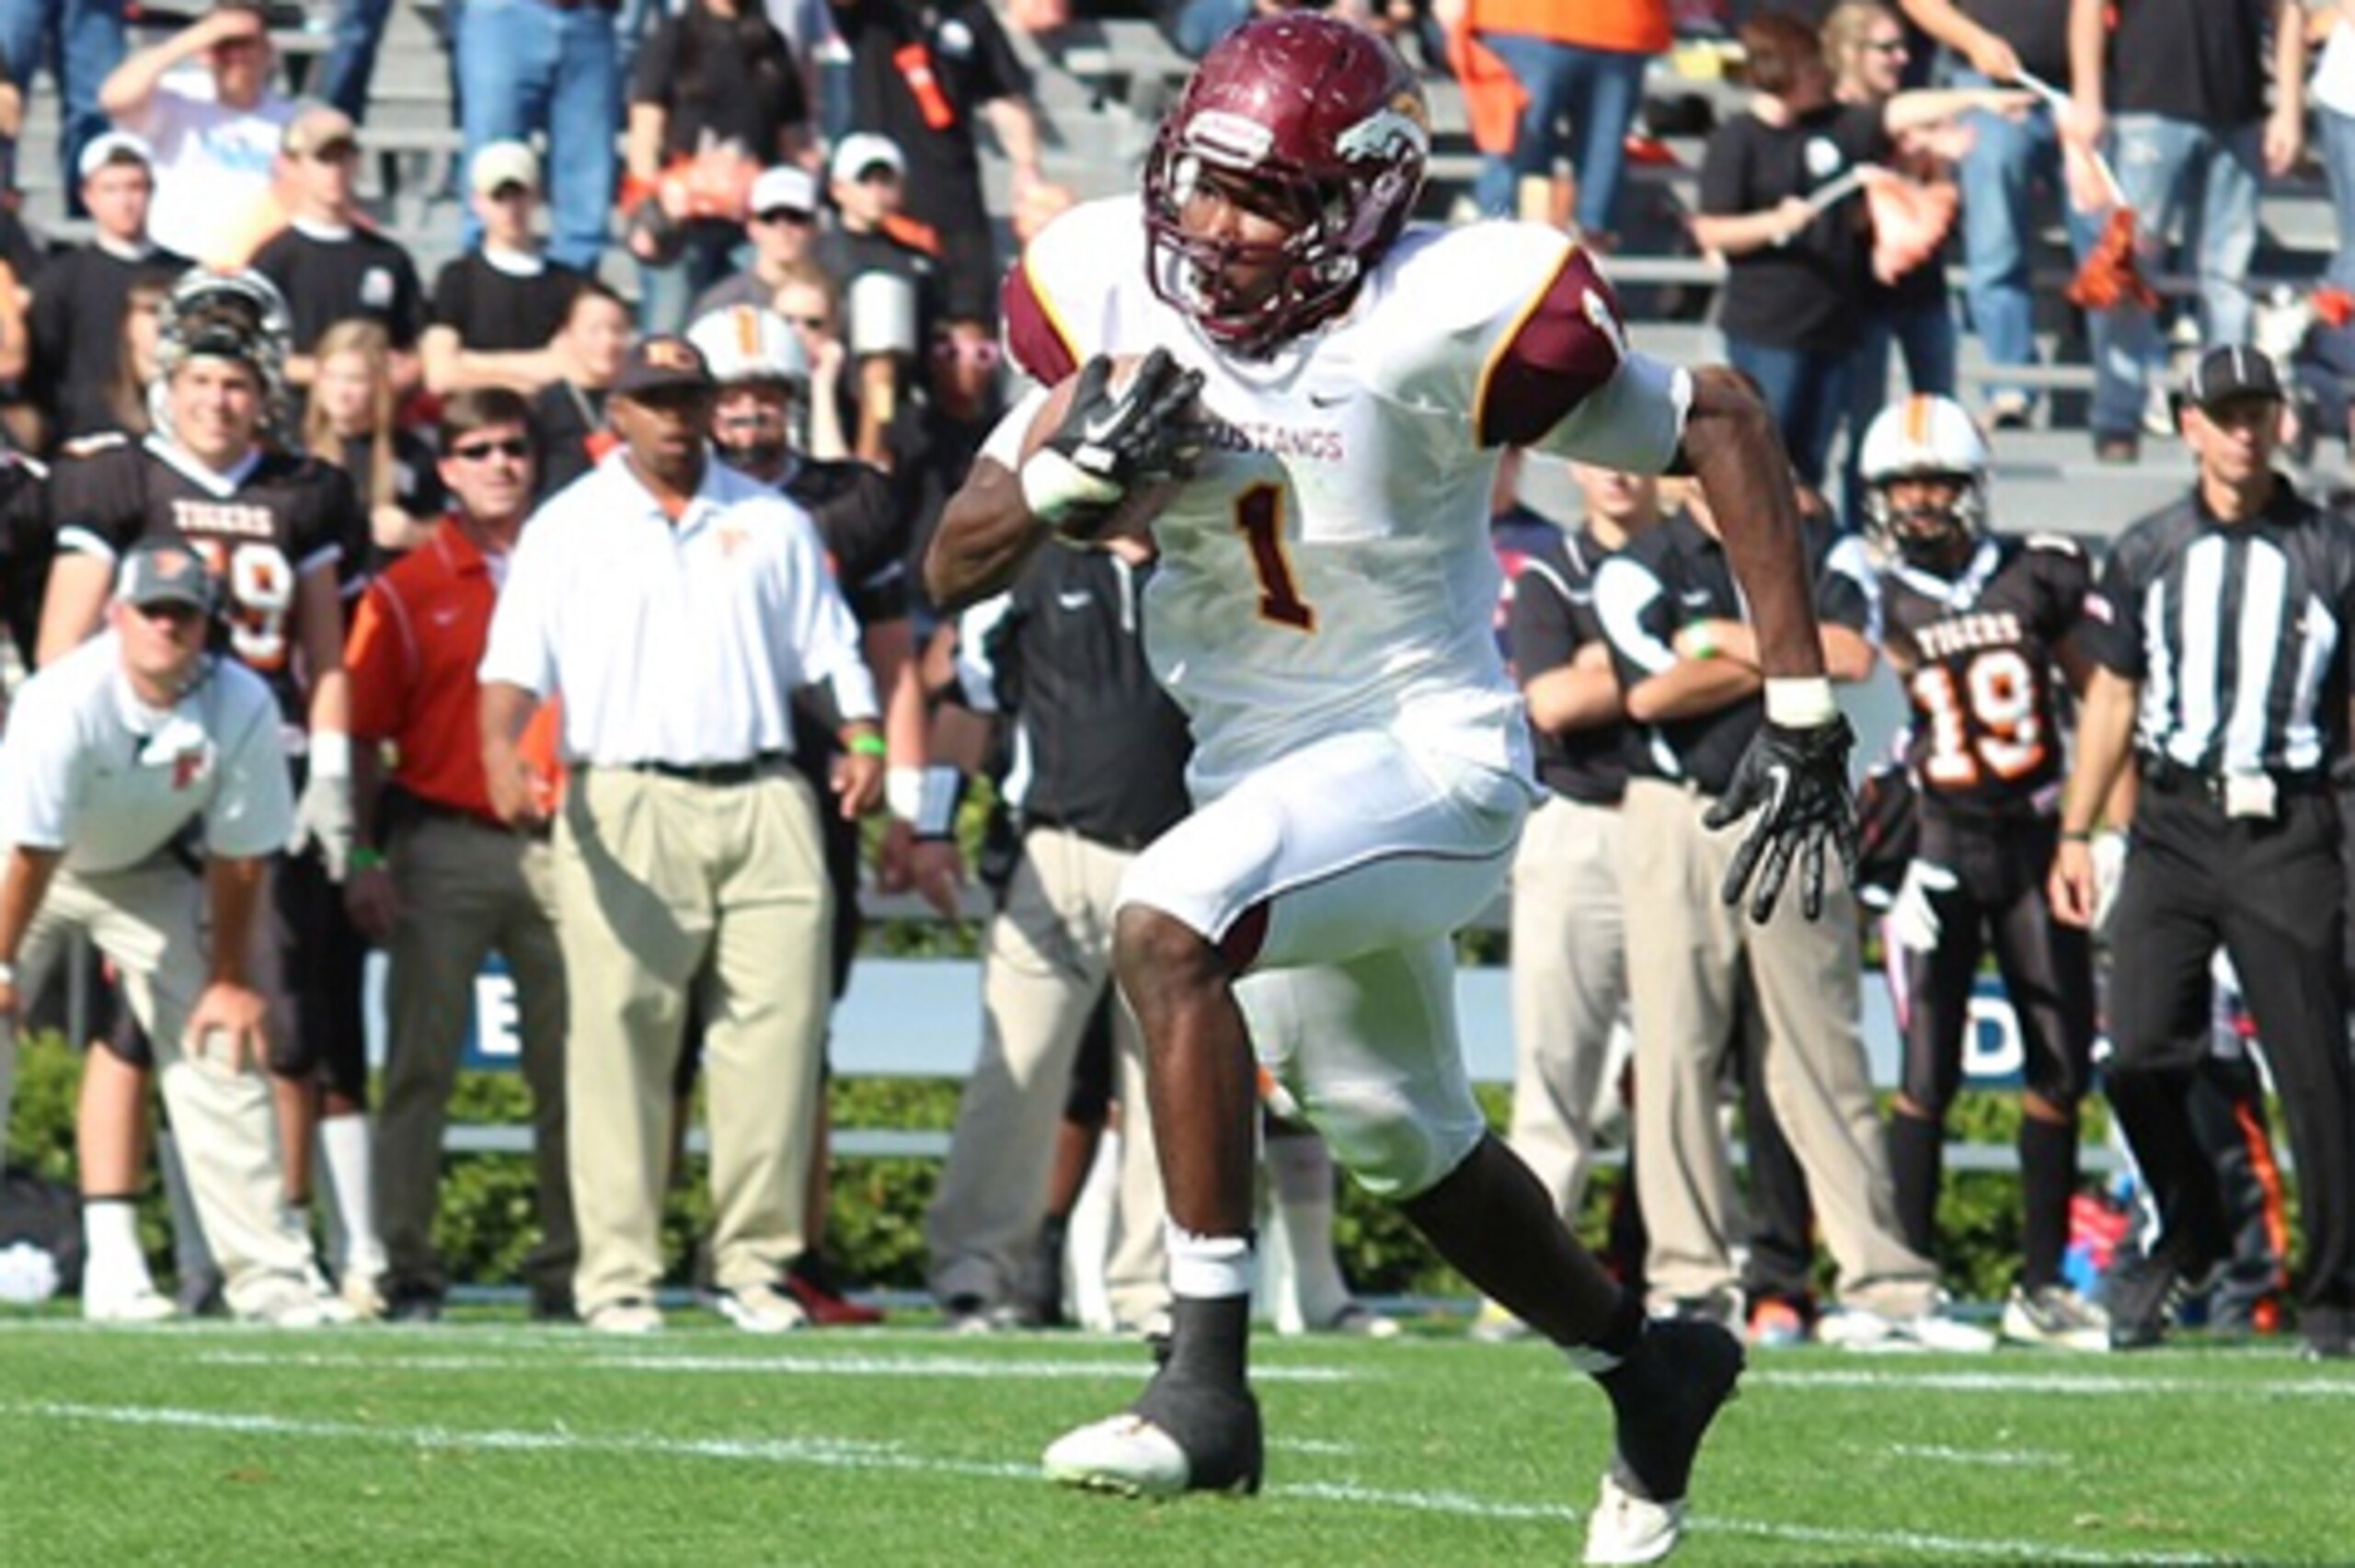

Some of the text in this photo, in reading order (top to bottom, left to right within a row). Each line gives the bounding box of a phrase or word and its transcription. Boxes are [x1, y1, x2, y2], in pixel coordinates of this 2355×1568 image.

[1209, 422, 1344, 461] USTANGS
[172, 498, 273, 536] TIGERS
[1235, 480, 1316, 632] 1
[1915, 612, 2022, 658] TIGERS
[1913, 648, 2045, 784] 19
[475, 974, 522, 1054] E
[1962, 996, 2026, 1075] D
